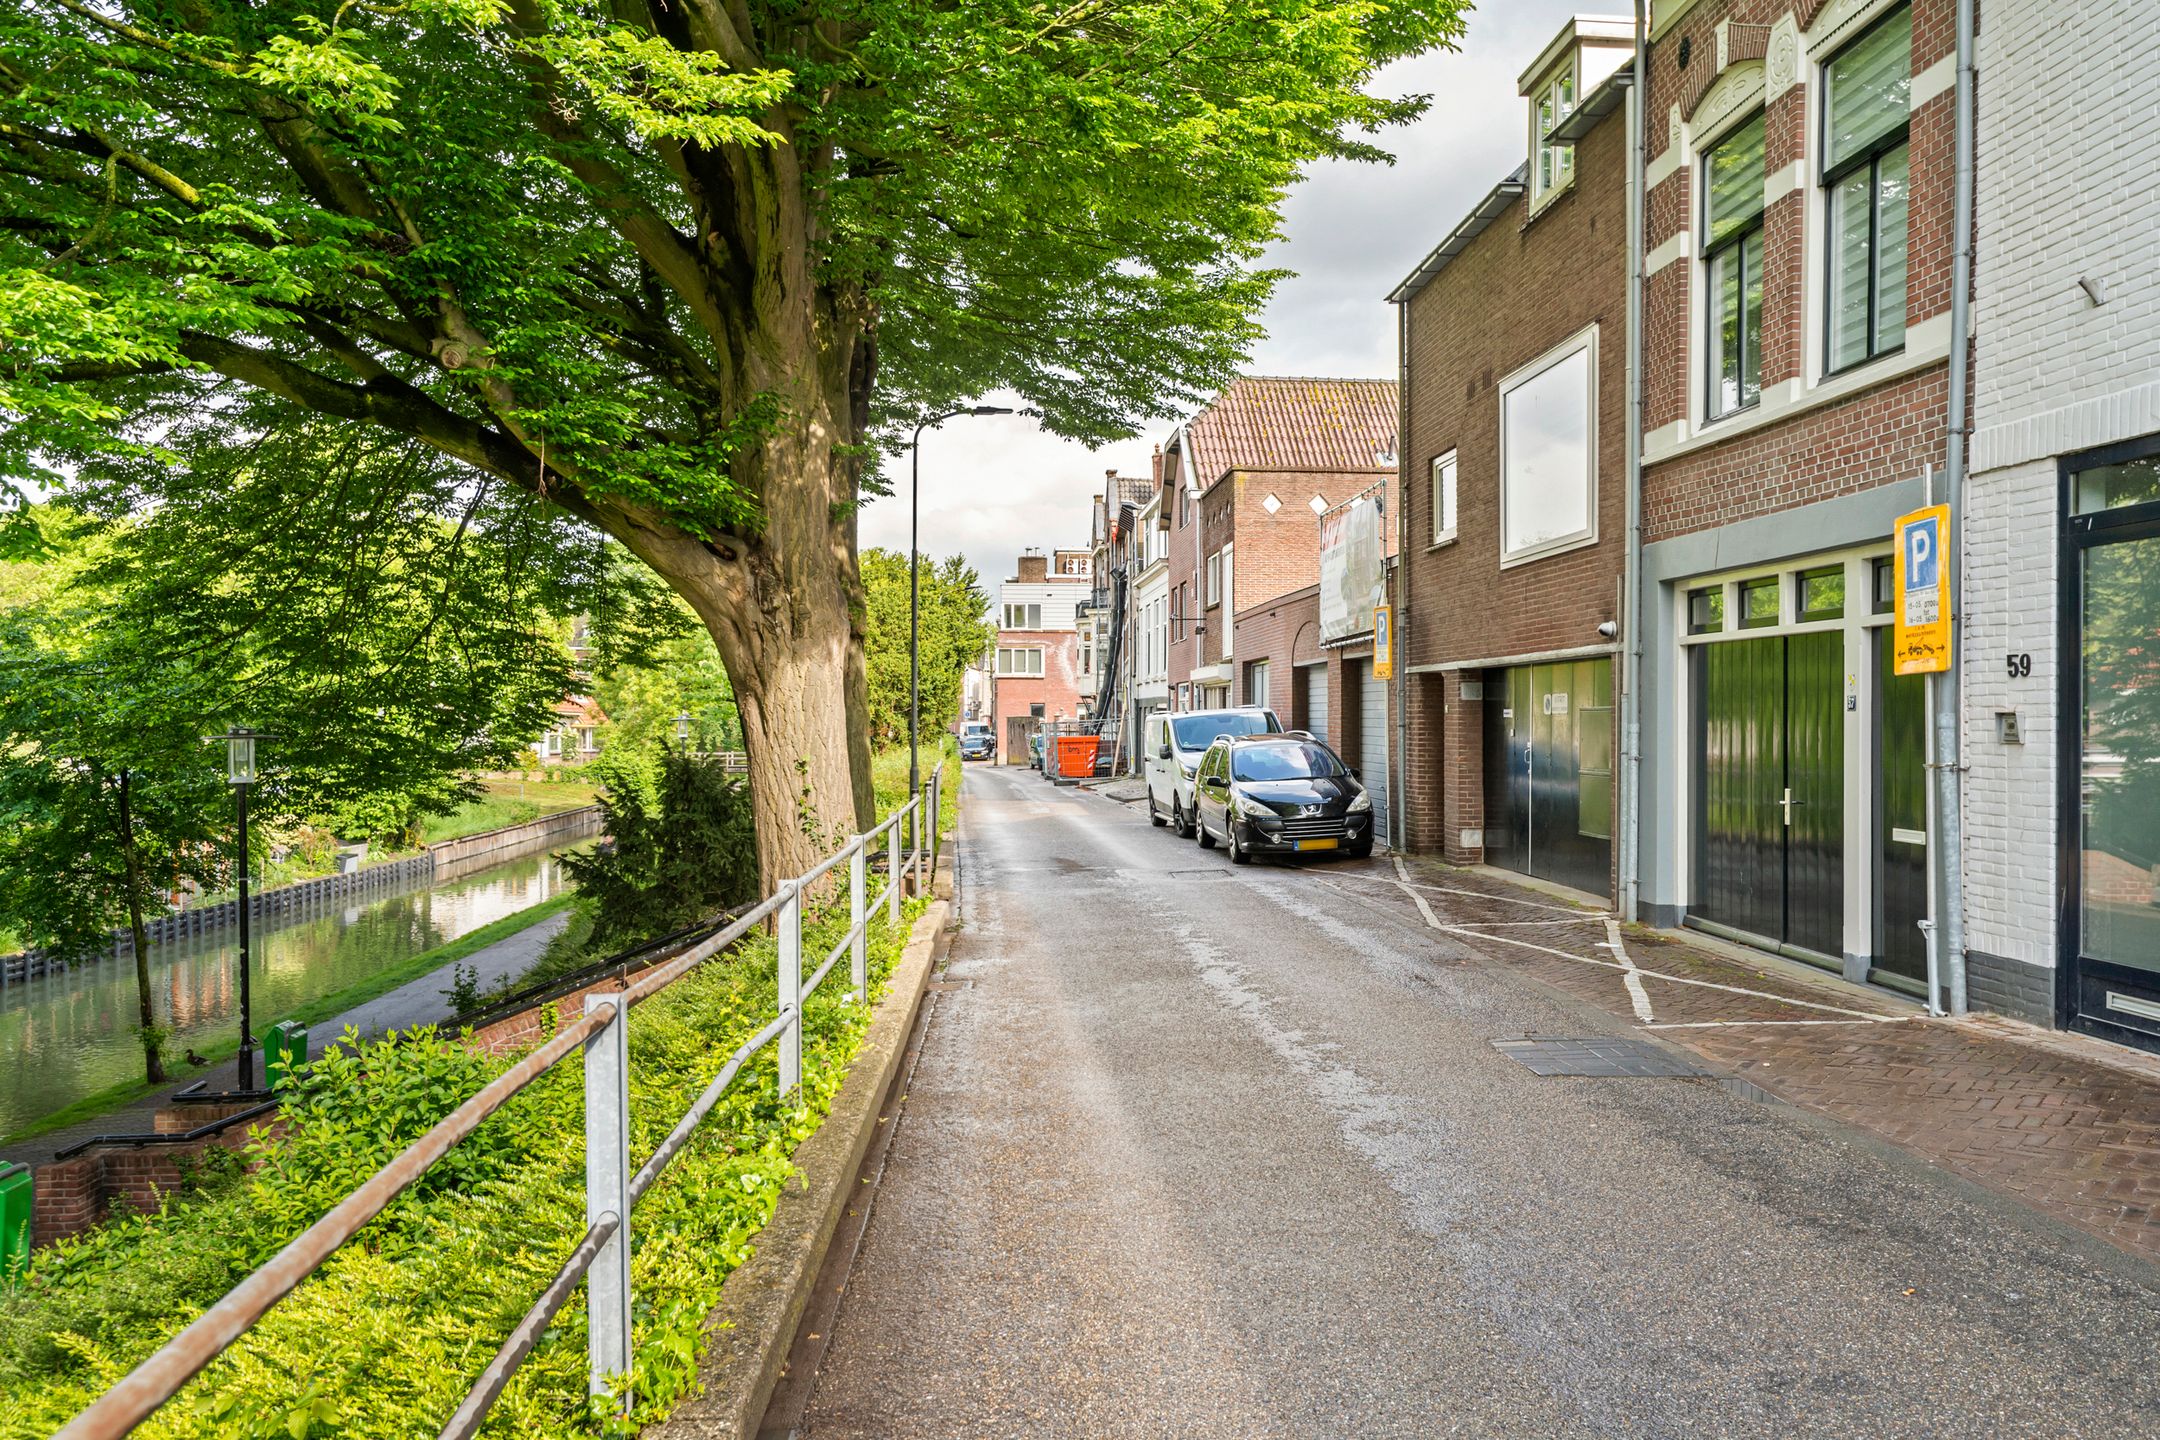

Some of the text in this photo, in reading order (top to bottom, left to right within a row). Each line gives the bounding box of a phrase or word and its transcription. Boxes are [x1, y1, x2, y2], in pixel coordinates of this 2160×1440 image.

[1912, 530, 1930, 582] P
[1378, 616, 1385, 642] P
[2007, 653, 2031, 677] 59
